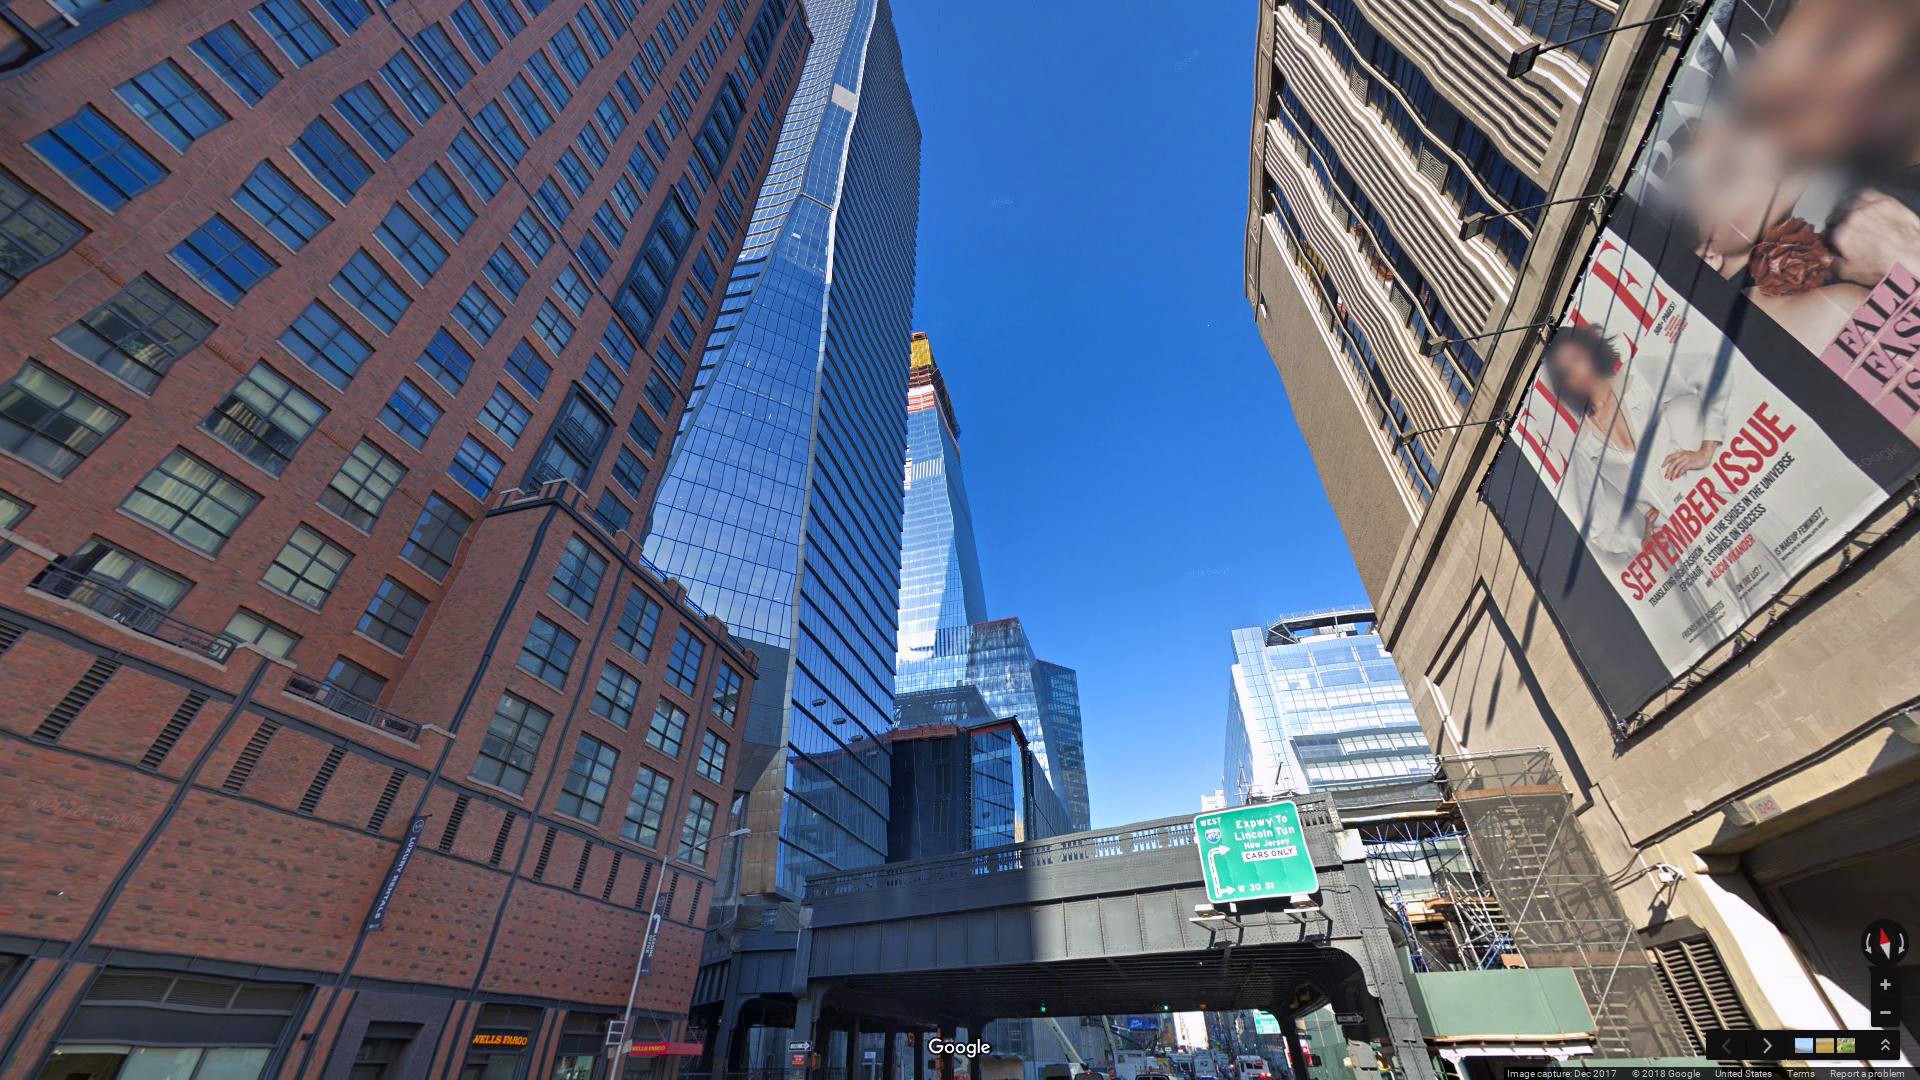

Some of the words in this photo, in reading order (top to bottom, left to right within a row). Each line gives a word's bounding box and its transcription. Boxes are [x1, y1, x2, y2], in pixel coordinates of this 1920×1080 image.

[1833, 273, 1920, 362] FALL
[1859, 304, 1920, 388] FAS
[1621, 476, 1728, 601] SEPTEMBER
[1712, 401, 1798, 494] ISSUE
[1737, 503, 1767, 534] SUCCESS
[1648, 575, 1678, 608] TRANSLATING
[1683, 544, 1705, 571] FASHION
[1705, 530, 1719, 546] ALL
[1713, 523, 1730, 538] THE
[1723, 502, 1747, 527] SHOES
[1740, 494, 1753, 508] IN
[1748, 484, 1764, 502] THE
[1760, 451, 1796, 494] UNIVERSE
[1728, 527, 1742, 542] ON
[1707, 535, 1734, 562] STORIES
[1727, 533, 1757, 566] VIKANDER
[1779, 530, 1799, 551] MAKEUP
[1703, 556, 1713, 566] 5
[1200, 816, 1221, 827] WEST
[1235, 817, 1272, 829] Expwy
[1274, 814, 1287, 823] To
[1207, 831, 1220, 839] 495
[1233, 829, 1273, 841] Lincoln
[1274, 825, 1295, 835] Tun
[1243, 841, 1260, 849] New
[1263, 838, 1289, 848] Jersey
[396, 836, 417, 873] LUXURY
[1245, 850, 1268, 859] CARS
[1271, 847, 1293, 856] ONLY
[374, 875, 399, 919] RENTALS
[472, 1034, 503, 1045] WELLS
[502, 1035, 529, 1046] FARGO
